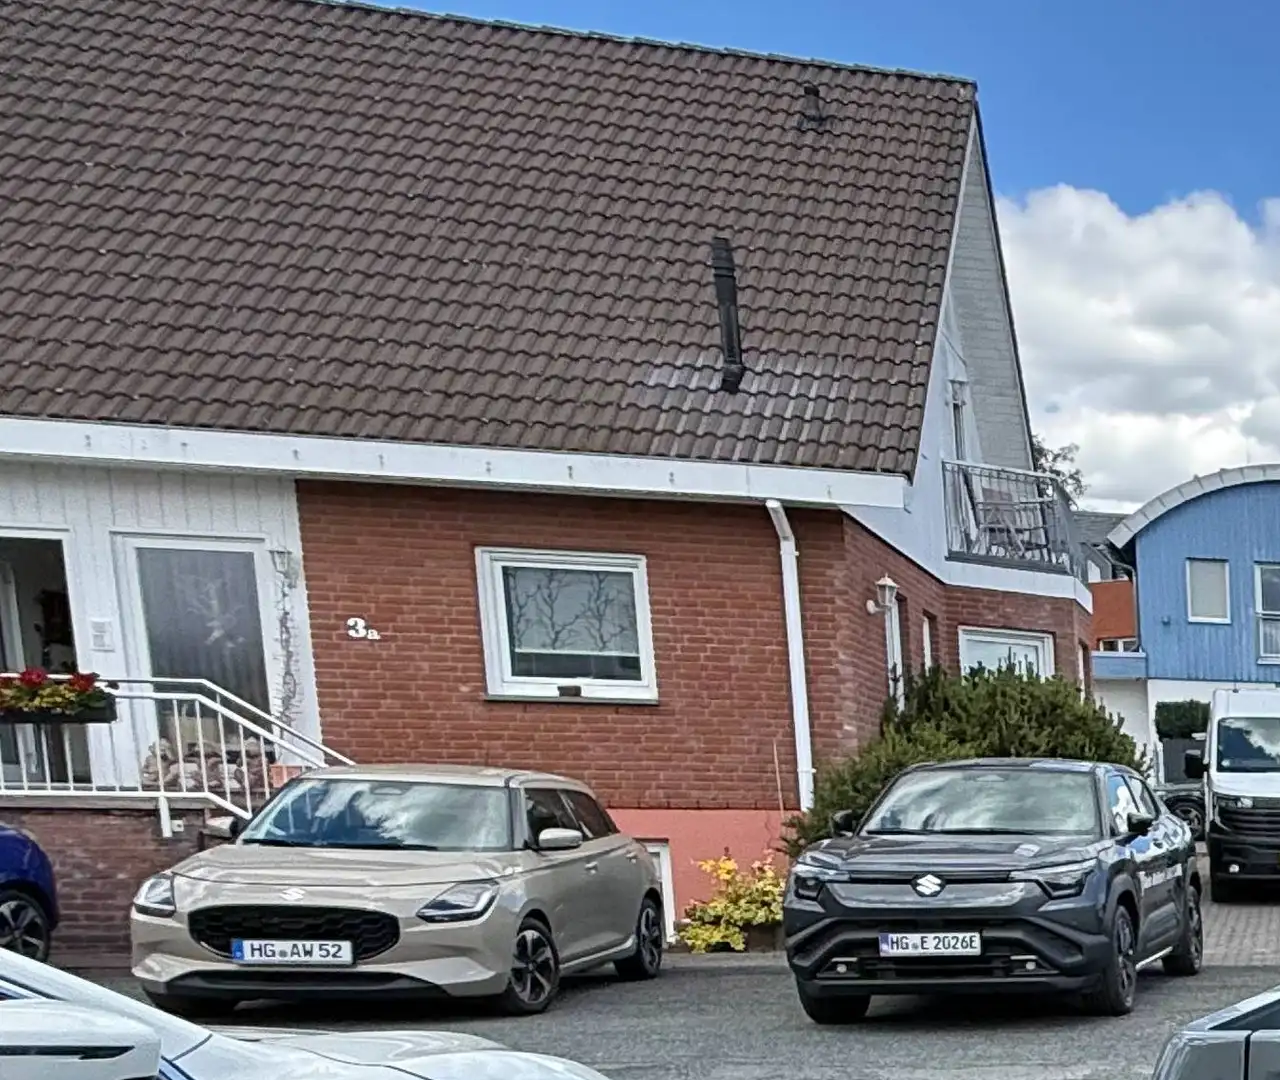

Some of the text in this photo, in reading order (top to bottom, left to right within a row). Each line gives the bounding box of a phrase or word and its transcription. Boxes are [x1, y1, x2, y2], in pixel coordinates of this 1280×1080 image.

[346, 616, 381, 640] 3a
[250, 943, 343, 959] HG AW 52
[890, 935, 910, 951] HG
[933, 934, 978, 951] 2026E
